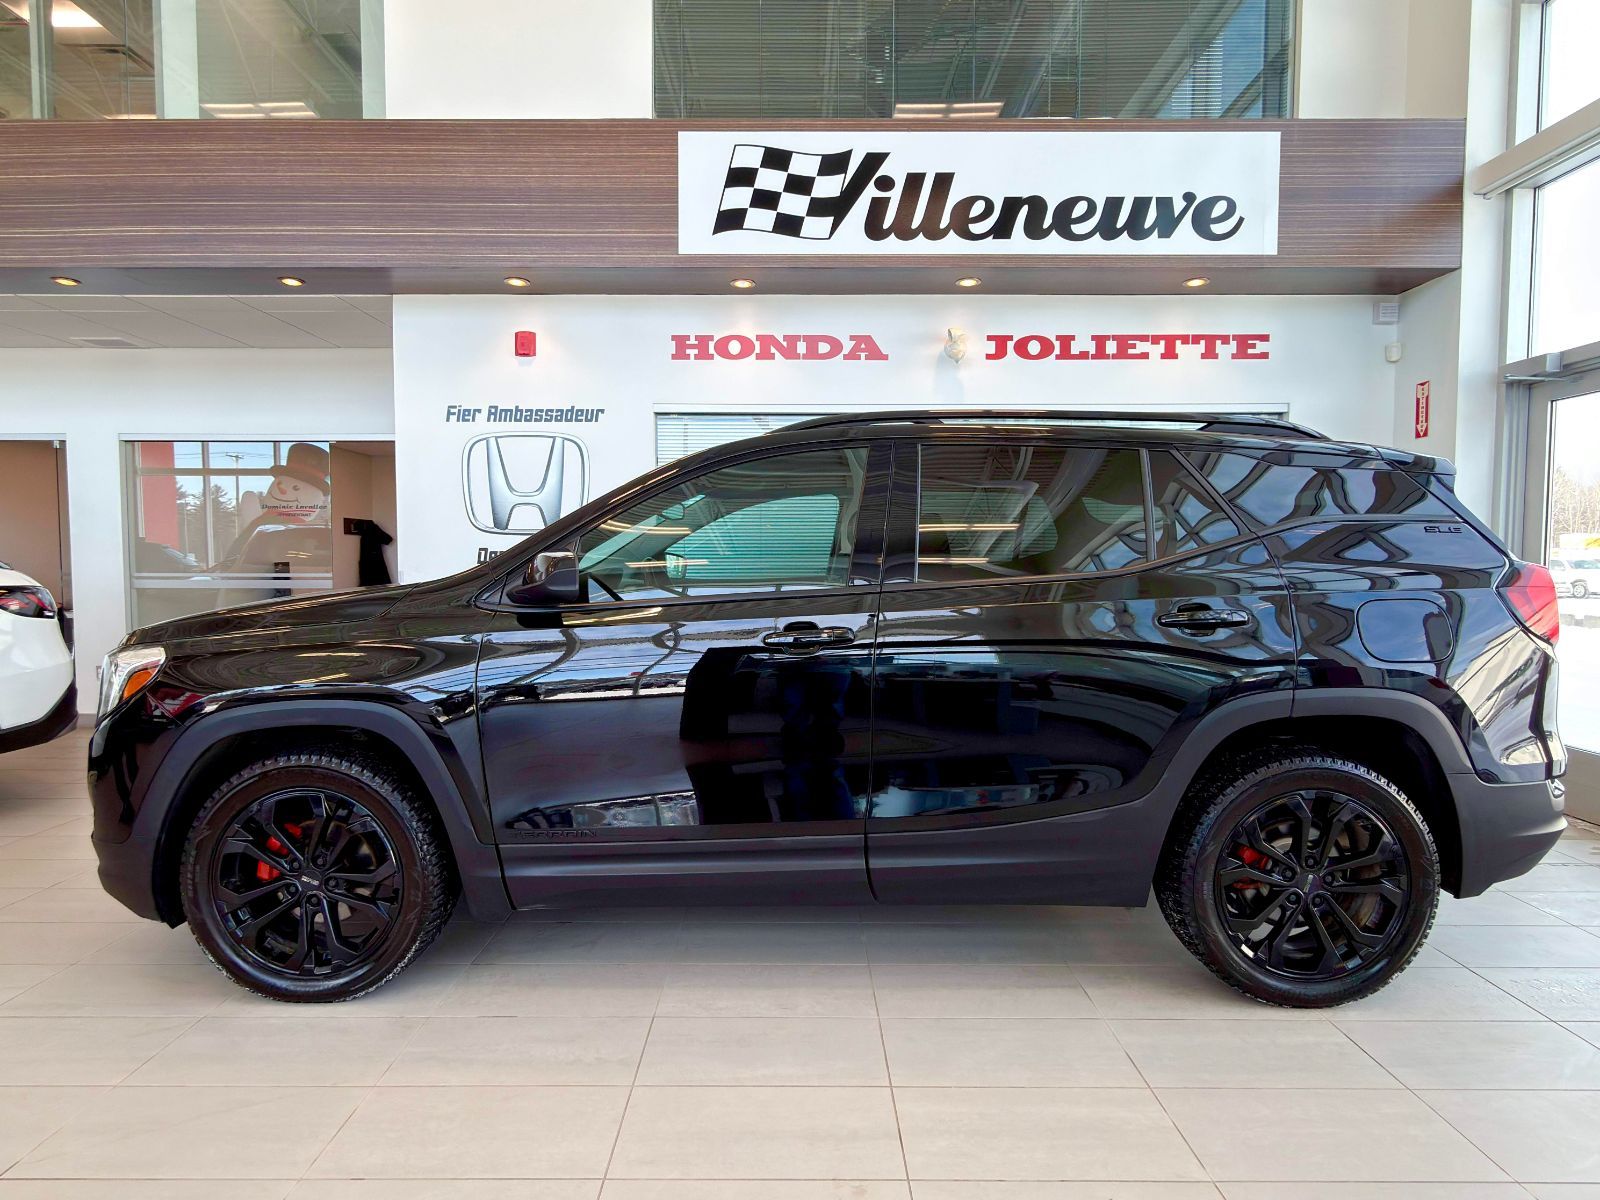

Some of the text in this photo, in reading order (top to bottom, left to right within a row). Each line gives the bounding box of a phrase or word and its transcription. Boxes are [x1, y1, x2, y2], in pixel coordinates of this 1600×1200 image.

[808, 148, 1245, 242] Villeneuve
[671, 334, 1270, 361] HONDA JOLIETTE
[445, 405, 605, 423] Fier Ambassadeur
[1423, 525, 1463, 534] SLE
